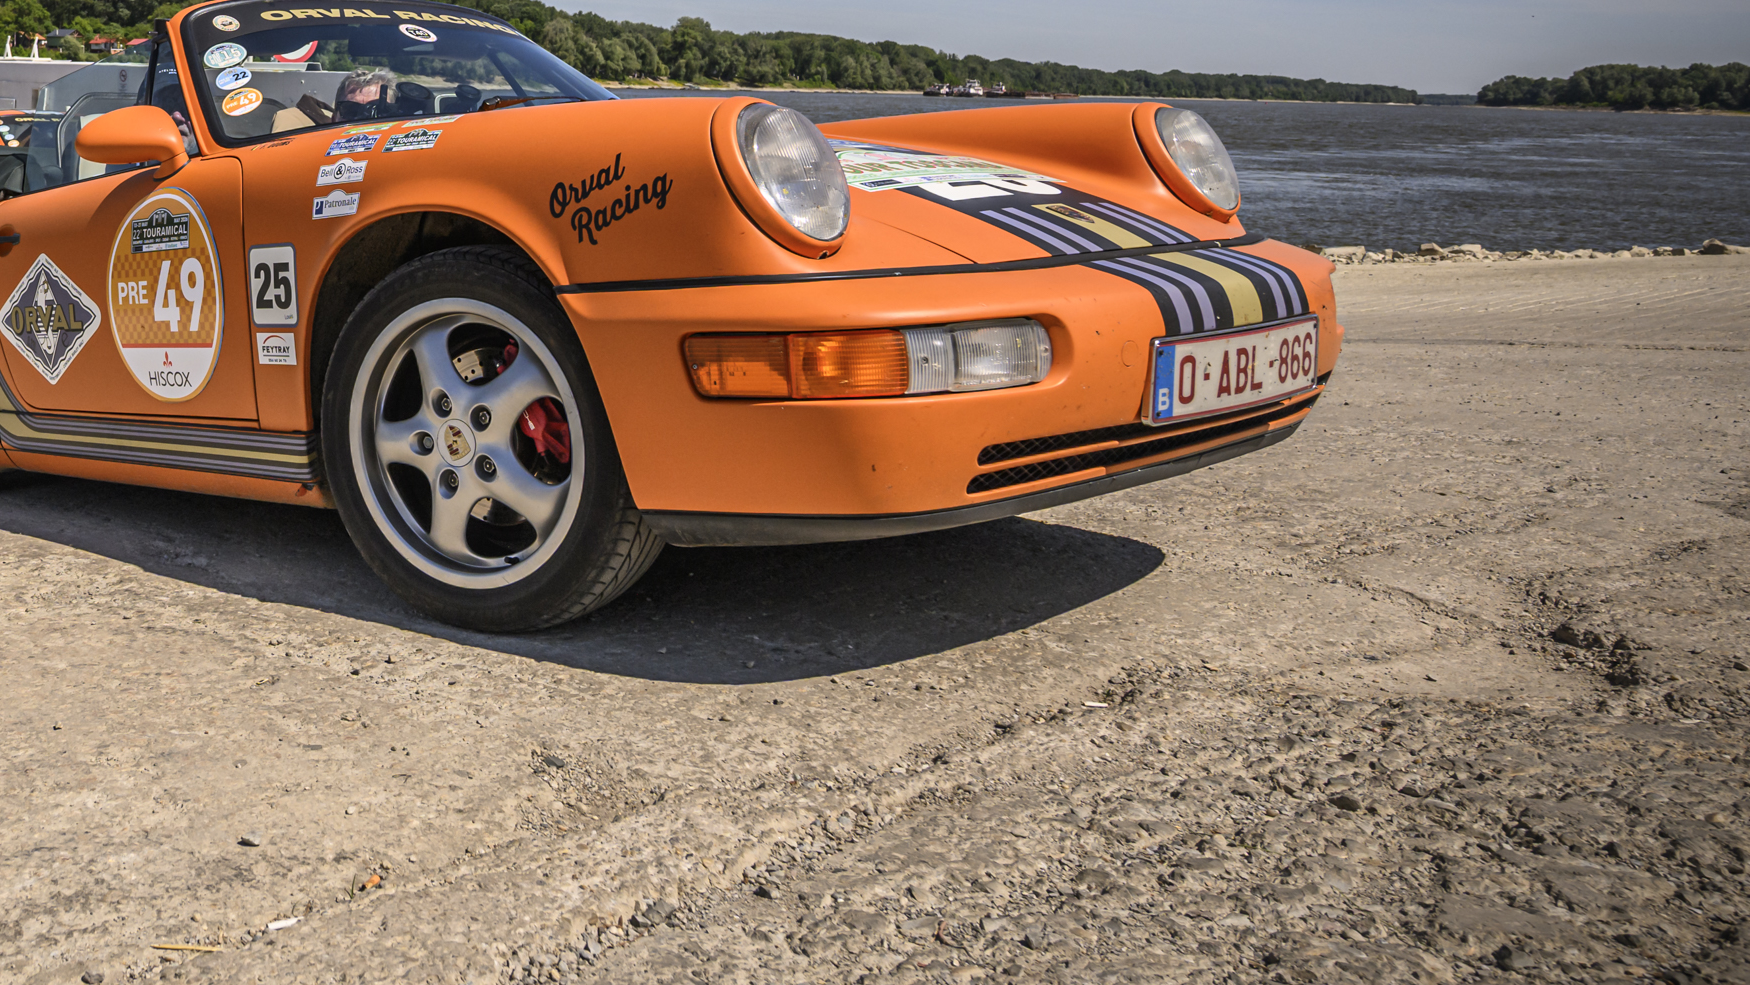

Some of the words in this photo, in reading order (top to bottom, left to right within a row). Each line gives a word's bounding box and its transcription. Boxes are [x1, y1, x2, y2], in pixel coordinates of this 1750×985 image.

[260, 8, 391, 21] ORVAL
[393, 10, 520, 35] RACING
[232, 71, 249, 82] 22
[239, 92, 257, 106] 49
[397, 134, 436, 144] TOURAMICAL
[320, 168, 333, 178] Bell
[346, 165, 363, 175] Ross
[549, 152, 625, 219] Orval
[324, 196, 357, 209] Patronale
[571, 172, 673, 245] Racing
[142, 224, 187, 238] TOURAMICAL
[117, 280, 149, 305] PRE
[154, 257, 205, 332] 49
[254, 262, 293, 310] 25
[11, 303, 84, 336] ORVAL
[262, 345, 291, 354] FEYTRAY
[148, 371, 193, 388] HISCOX
[1158, 388, 1170, 411] B
